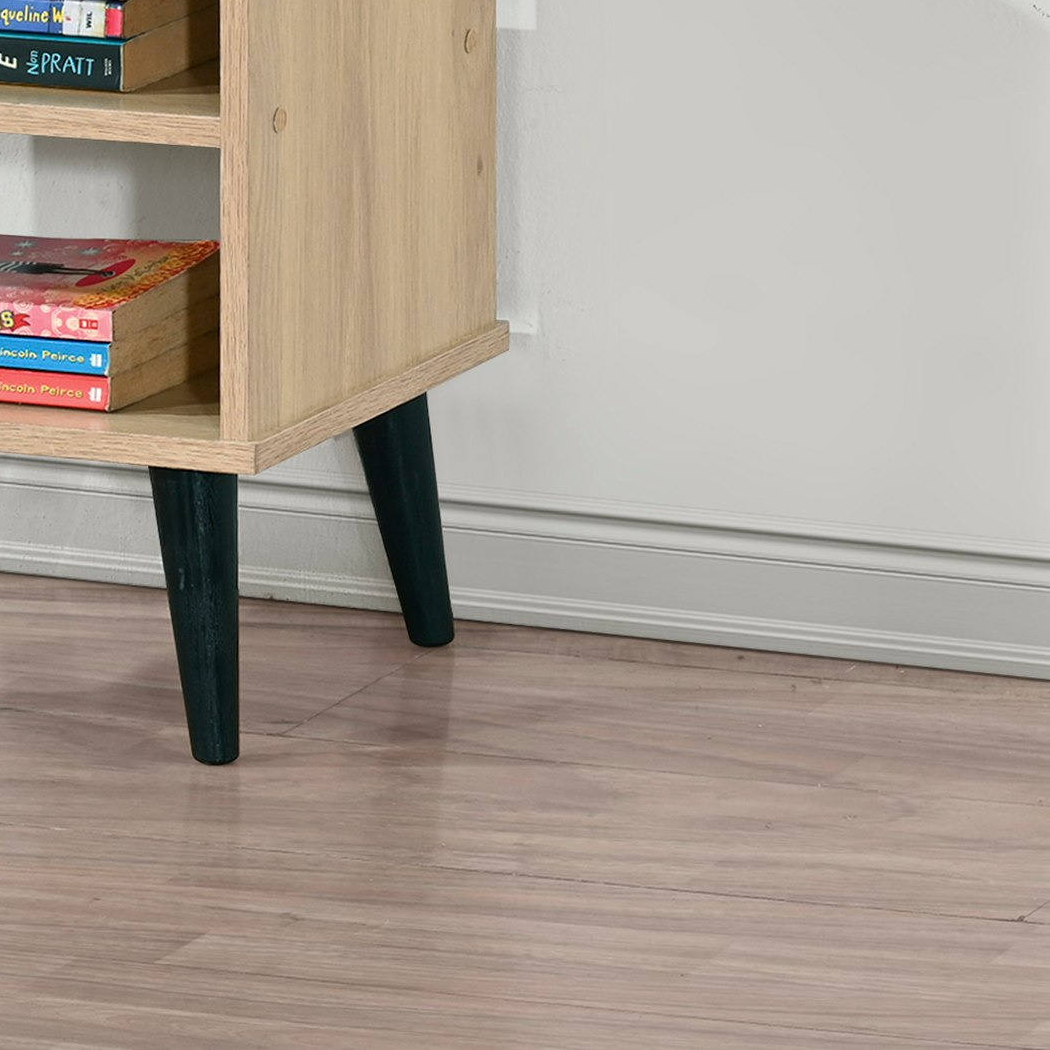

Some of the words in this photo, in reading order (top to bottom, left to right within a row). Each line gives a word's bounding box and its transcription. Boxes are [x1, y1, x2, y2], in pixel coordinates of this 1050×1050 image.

[85, 11, 93, 29] WIL
[26, 50, 39, 75] Non
[41, 52, 95, 76] PRATT
[42, 350, 86, 363] Peirce
[40, 385, 84, 398] Peirce
